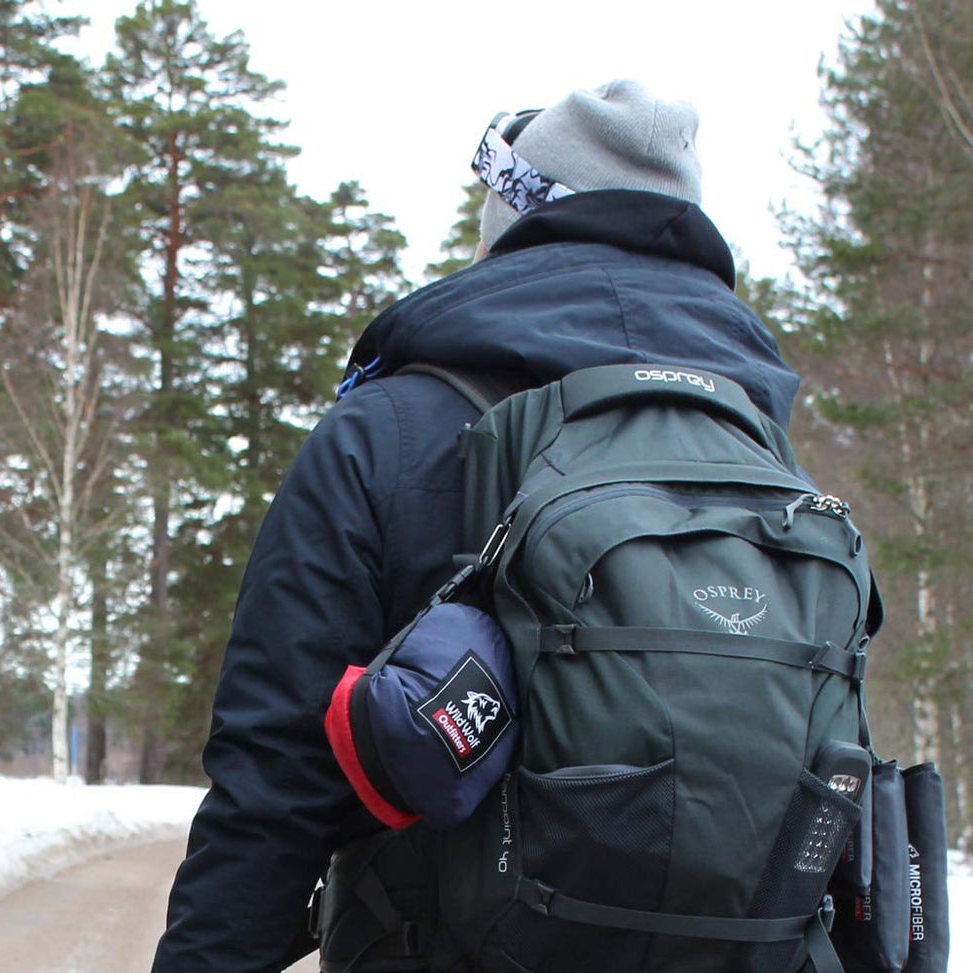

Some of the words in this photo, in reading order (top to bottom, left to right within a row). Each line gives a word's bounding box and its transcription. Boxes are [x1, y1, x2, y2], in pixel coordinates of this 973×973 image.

[634, 370, 715, 392] osprey
[693, 585, 766, 604] OSPREY
[438, 714, 466, 753] Outfitters
[909, 864, 924, 941] MICROFIBER
